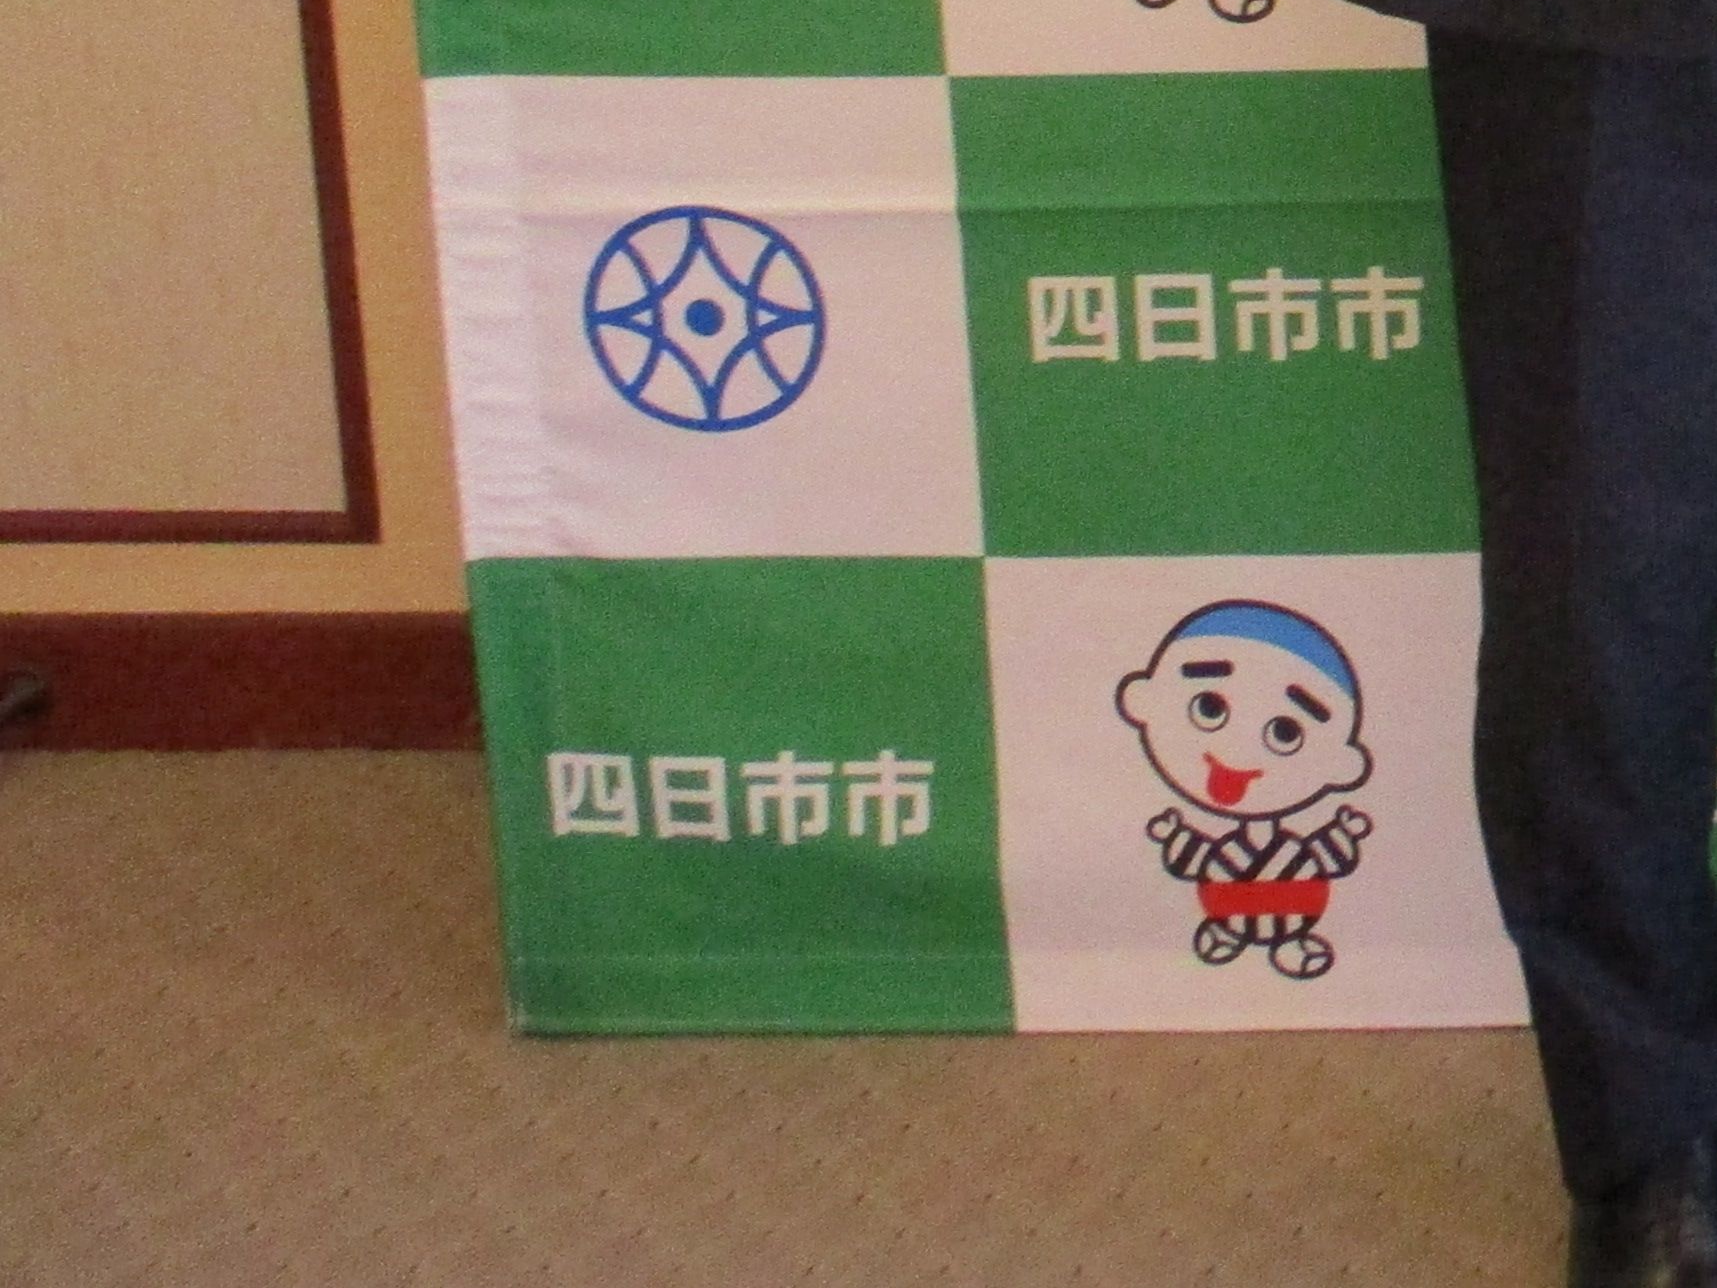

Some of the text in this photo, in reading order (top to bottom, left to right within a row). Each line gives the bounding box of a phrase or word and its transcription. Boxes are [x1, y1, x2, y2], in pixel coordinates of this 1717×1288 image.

[1027, 267, 1424, 363] 四日市市
[547, 749, 934, 846] 四日市市
